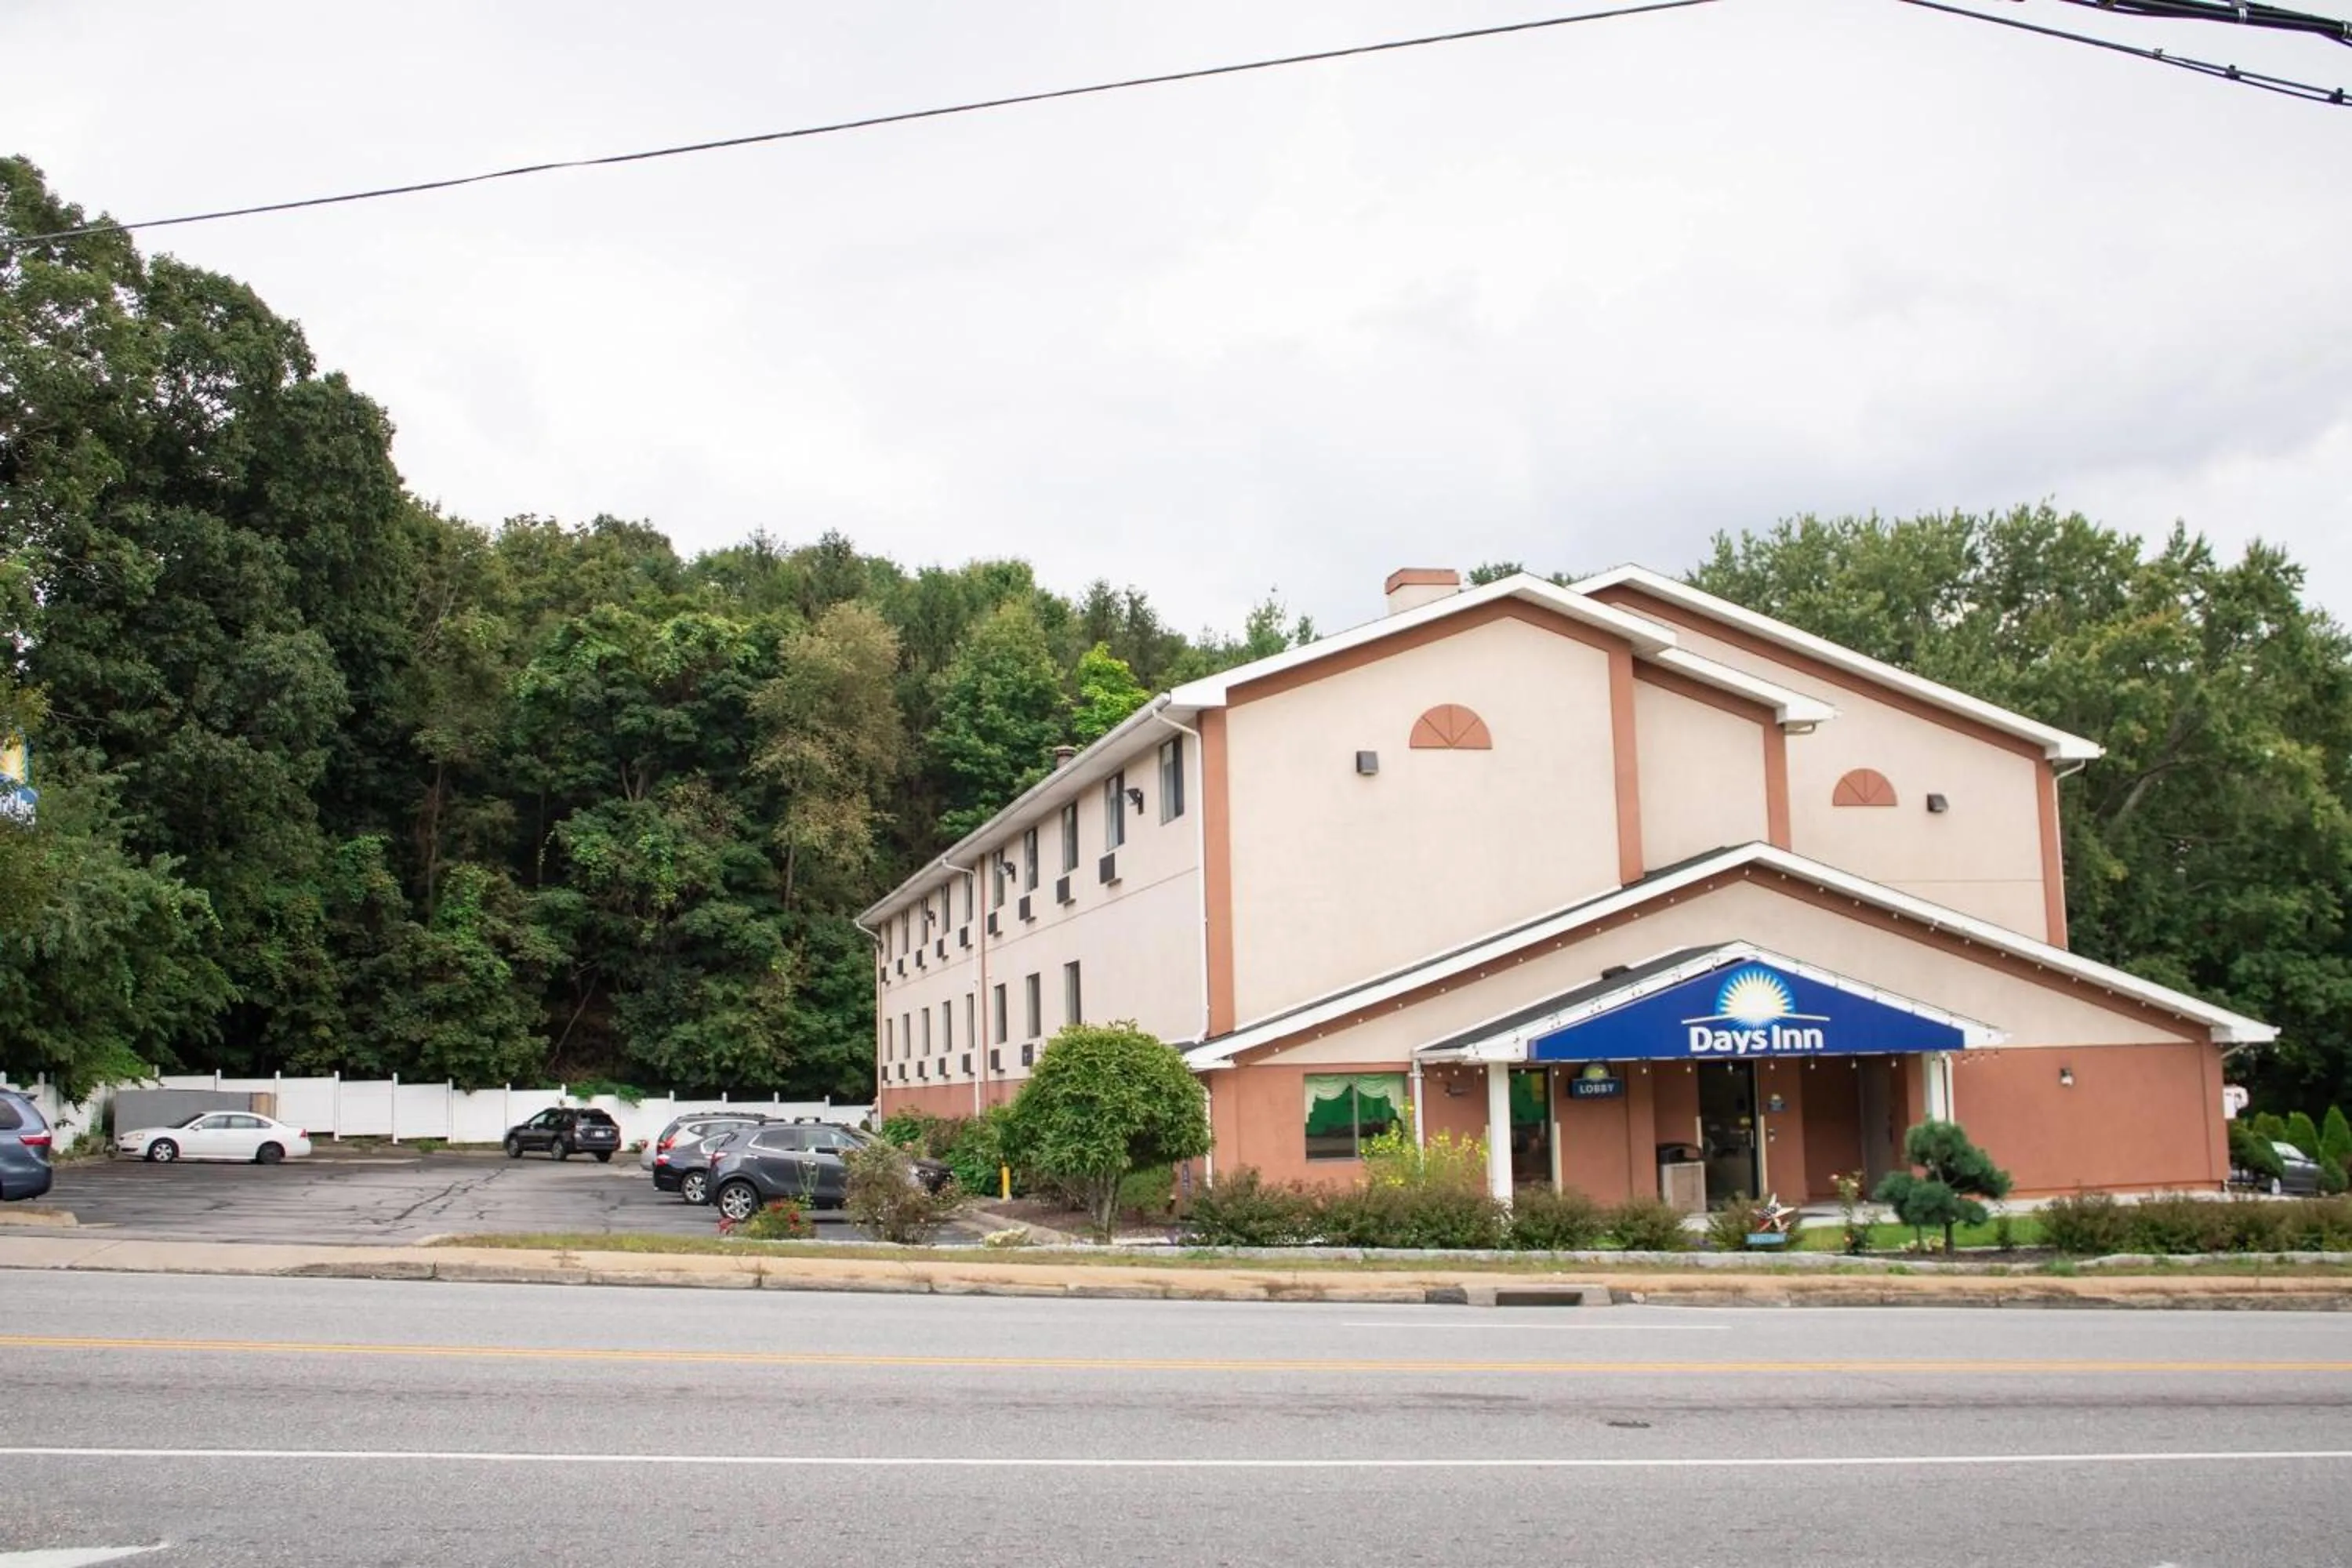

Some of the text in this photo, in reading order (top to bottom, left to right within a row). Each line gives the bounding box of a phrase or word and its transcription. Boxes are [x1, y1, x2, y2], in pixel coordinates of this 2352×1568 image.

[1690, 1024, 1824, 1054] Days Inn
[1579, 1083, 1615, 1094] LOBBY
